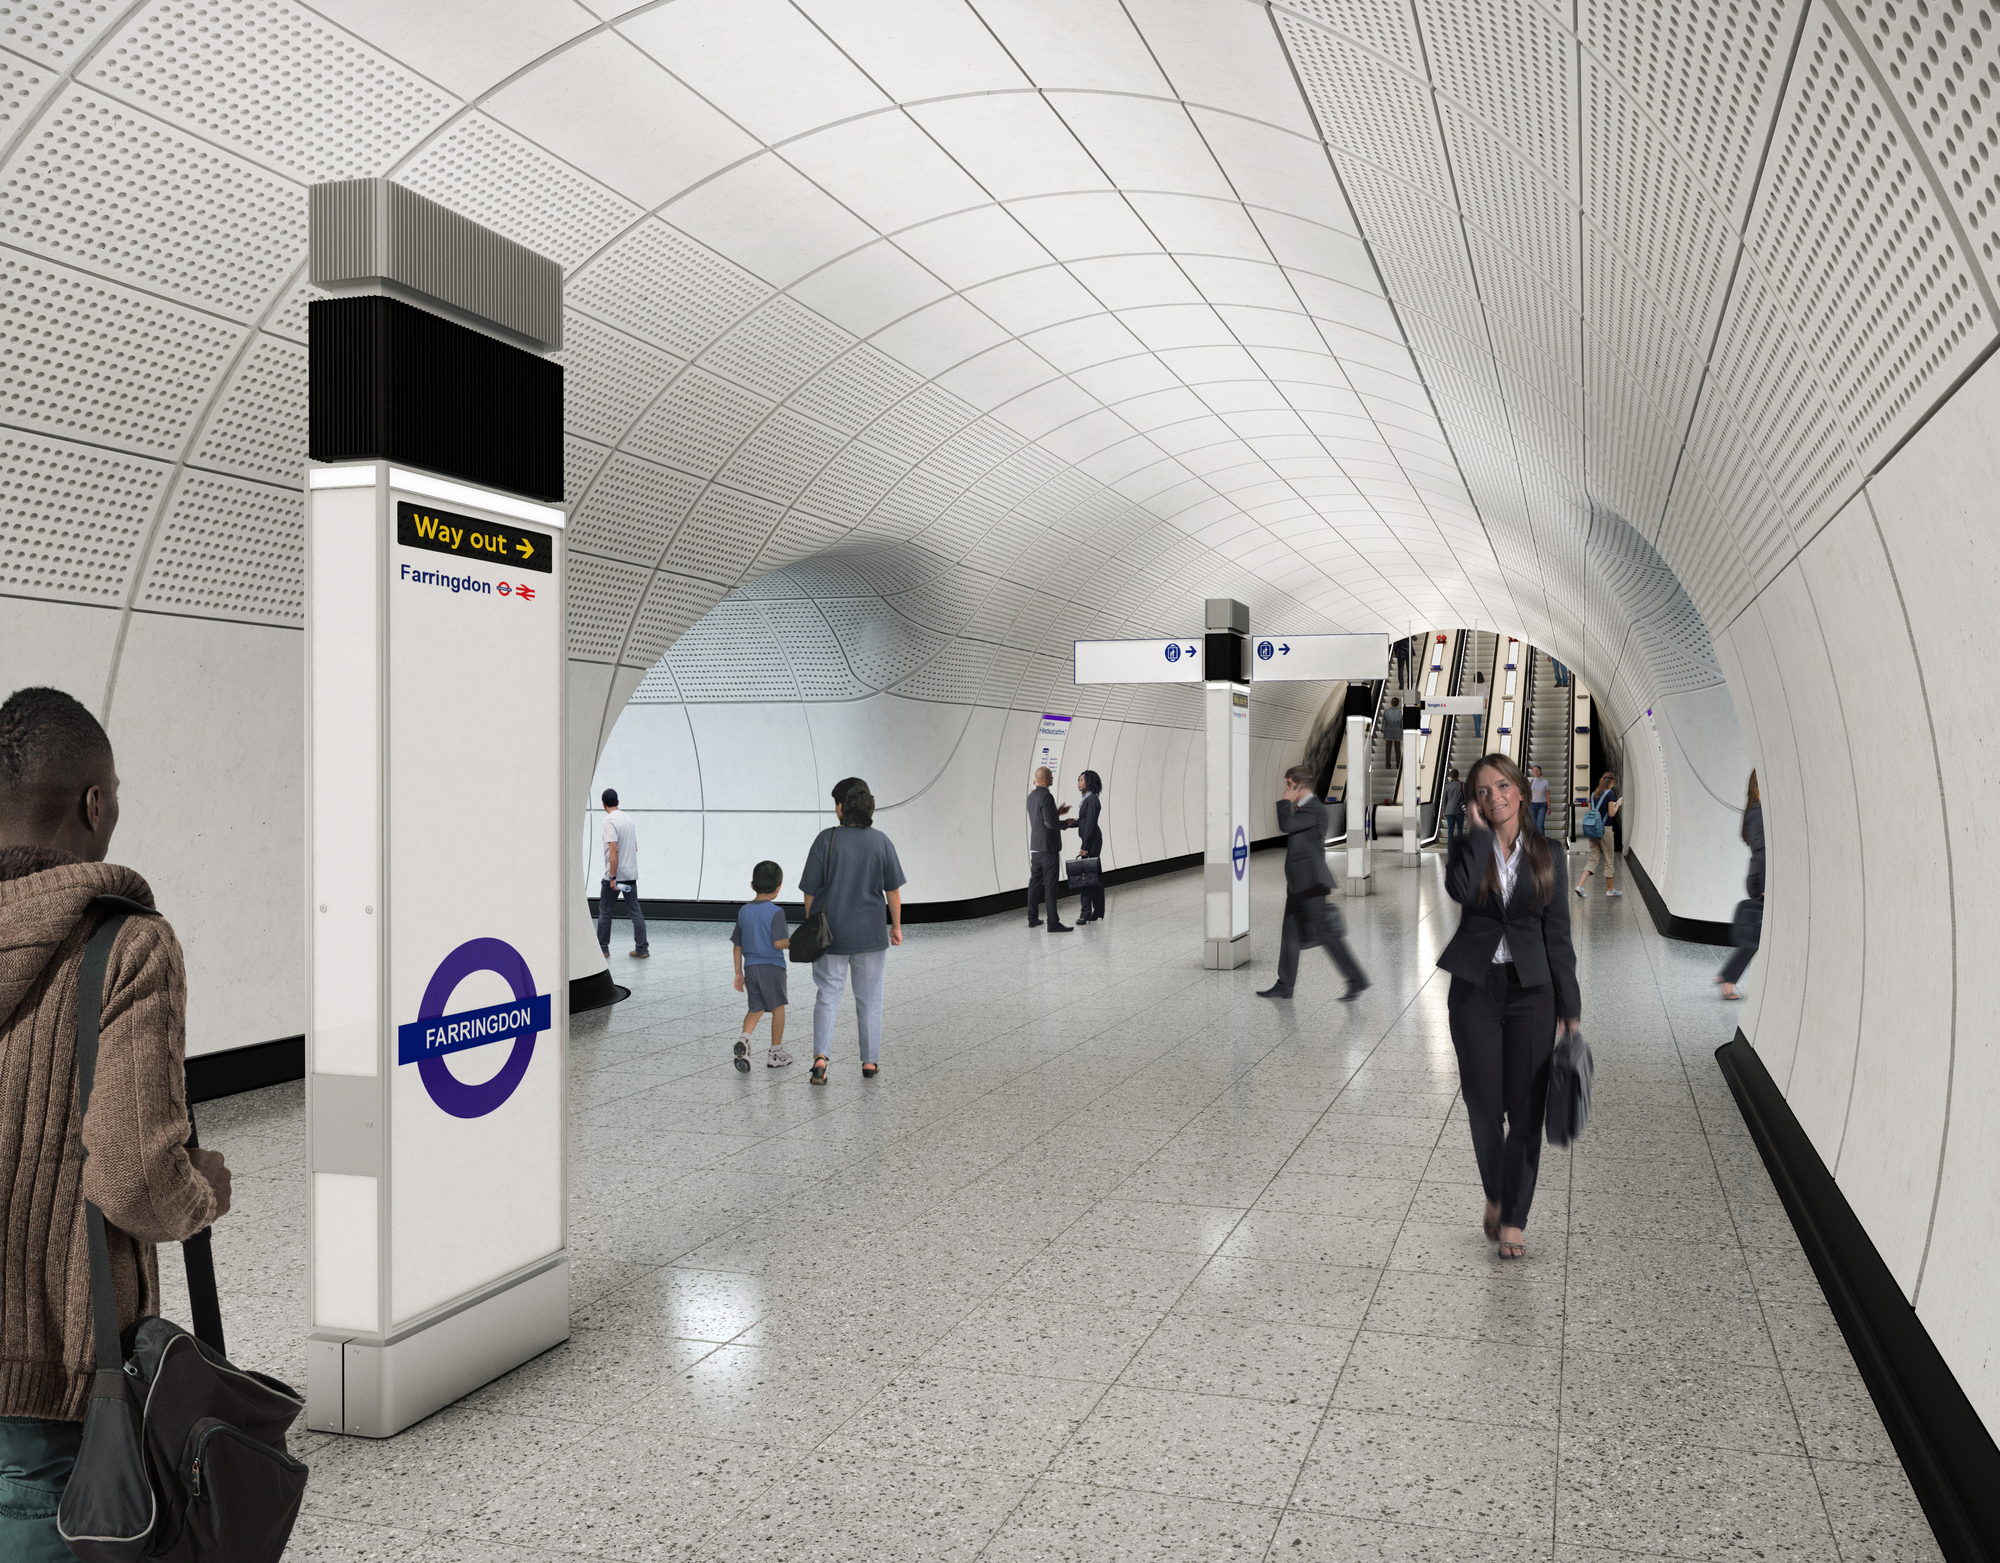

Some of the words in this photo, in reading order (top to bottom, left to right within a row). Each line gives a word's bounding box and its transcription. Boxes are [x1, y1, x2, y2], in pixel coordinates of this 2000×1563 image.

[413, 513, 464, 550] Way
[470, 532, 508, 555] out
[400, 563, 492, 594] Farringdon
[426, 1007, 531, 1050] FARRINGDON
